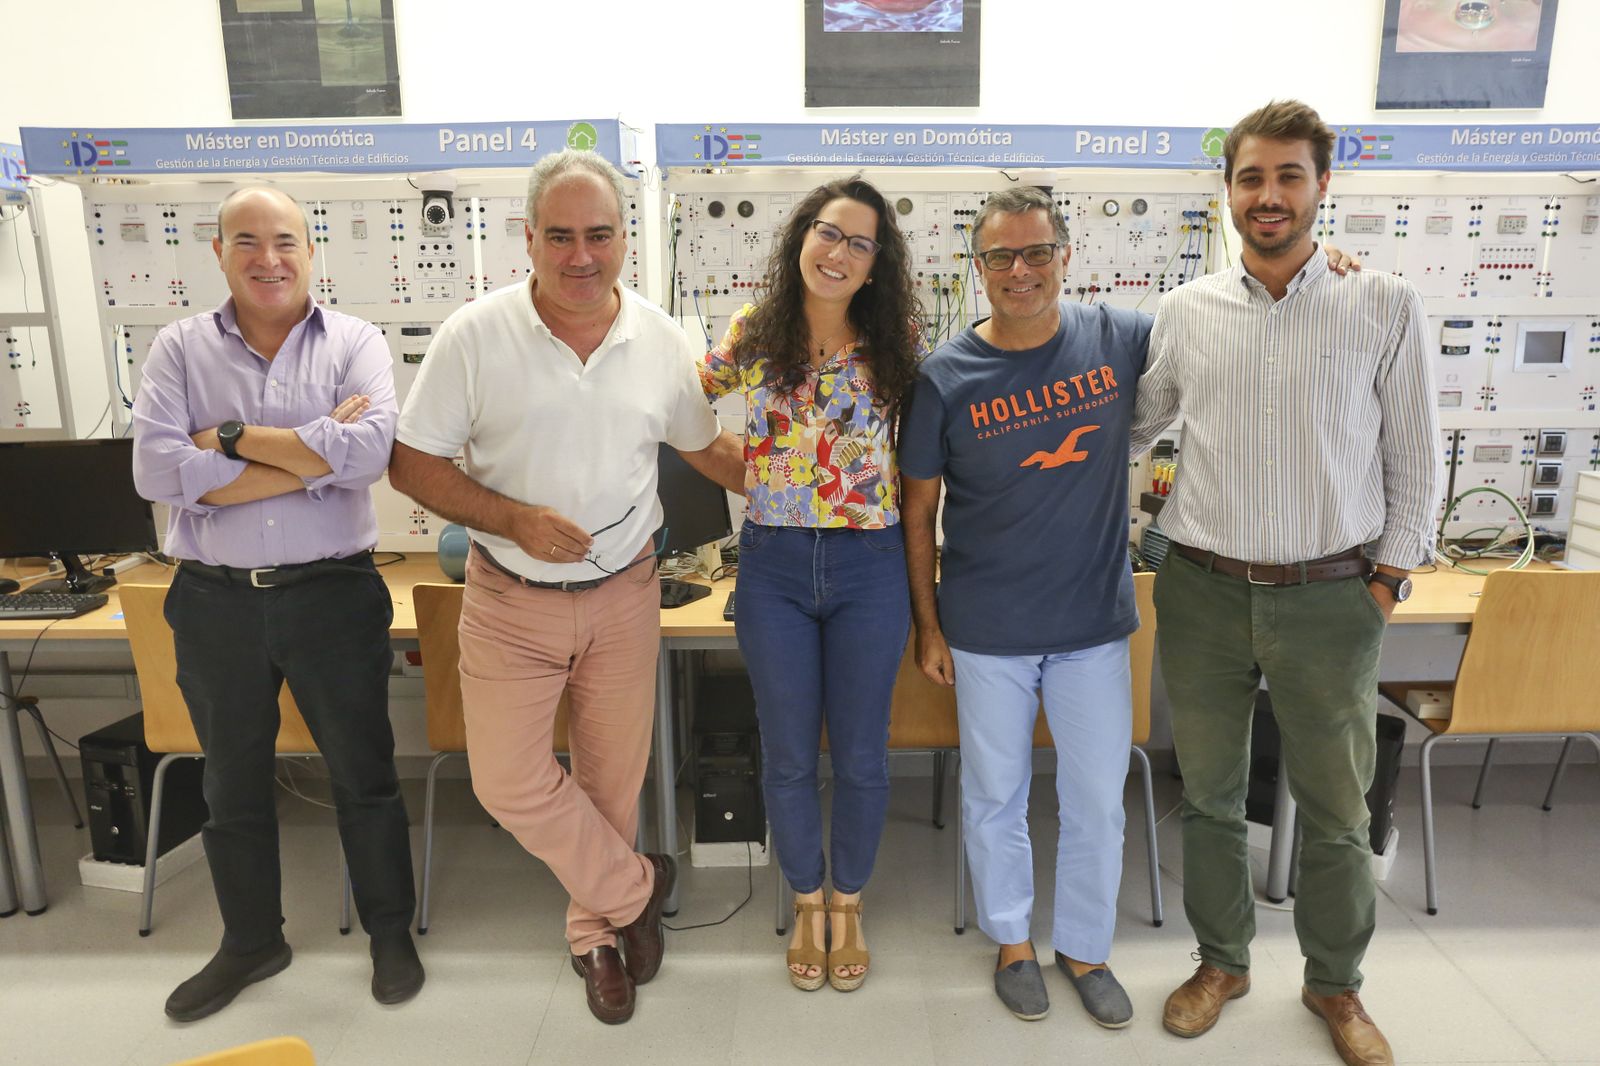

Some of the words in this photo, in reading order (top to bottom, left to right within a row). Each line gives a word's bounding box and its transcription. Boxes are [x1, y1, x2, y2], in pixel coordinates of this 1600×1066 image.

[185, 132, 252, 151] Máster
[257, 135, 280, 149] en
[284, 128, 375, 148] Domótica
[439, 126, 513, 153] Panel
[520, 127, 537, 152] 4
[821, 128, 889, 146] Máster
[893, 132, 917, 145] en
[922, 128, 1013, 146] Domótica
[1075, 129, 1149, 155] Panel
[1155, 131, 1171, 156] 3
[1451, 127, 1517, 146] Máster
[1520, 131, 1543, 145] en
[155, 158, 195, 169] Gestión
[196, 157, 209, 168] de
[211, 157, 221, 168] la
[223, 156, 260, 169] Energía
[262, 158, 269, 168] y
[271, 154, 310, 166] Gestión
[311, 154, 350, 165] Técnica
[352, 154, 365, 164] de
[367, 152, 409, 164] Edificios
[787, 152, 827, 163] Gestión
[829, 152, 842, 163] de
[845, 152, 854, 163] la
[857, 152, 895, 164] Energía
[897, 154, 903, 164] y
[905, 152, 945, 163] Gestión
[947, 151, 985, 163] Técnica
[988, 152, 1001, 163] de
[1003, 151, 1046, 163] Edificios
[1416, 152, 1454, 164] Gestión
[1456, 152, 1469, 163] de
[1472, 152, 1480, 163] la
[1483, 152, 1520, 164] Energía
[1521, 154, 1528, 163] y
[1530, 151, 1568, 163] Gestión
[969, 365, 1118, 429] HOLLISTER
[977, 414, 1051, 440] CALIFORNIA
[1056, 391, 1120, 419] SURFBOARDS
